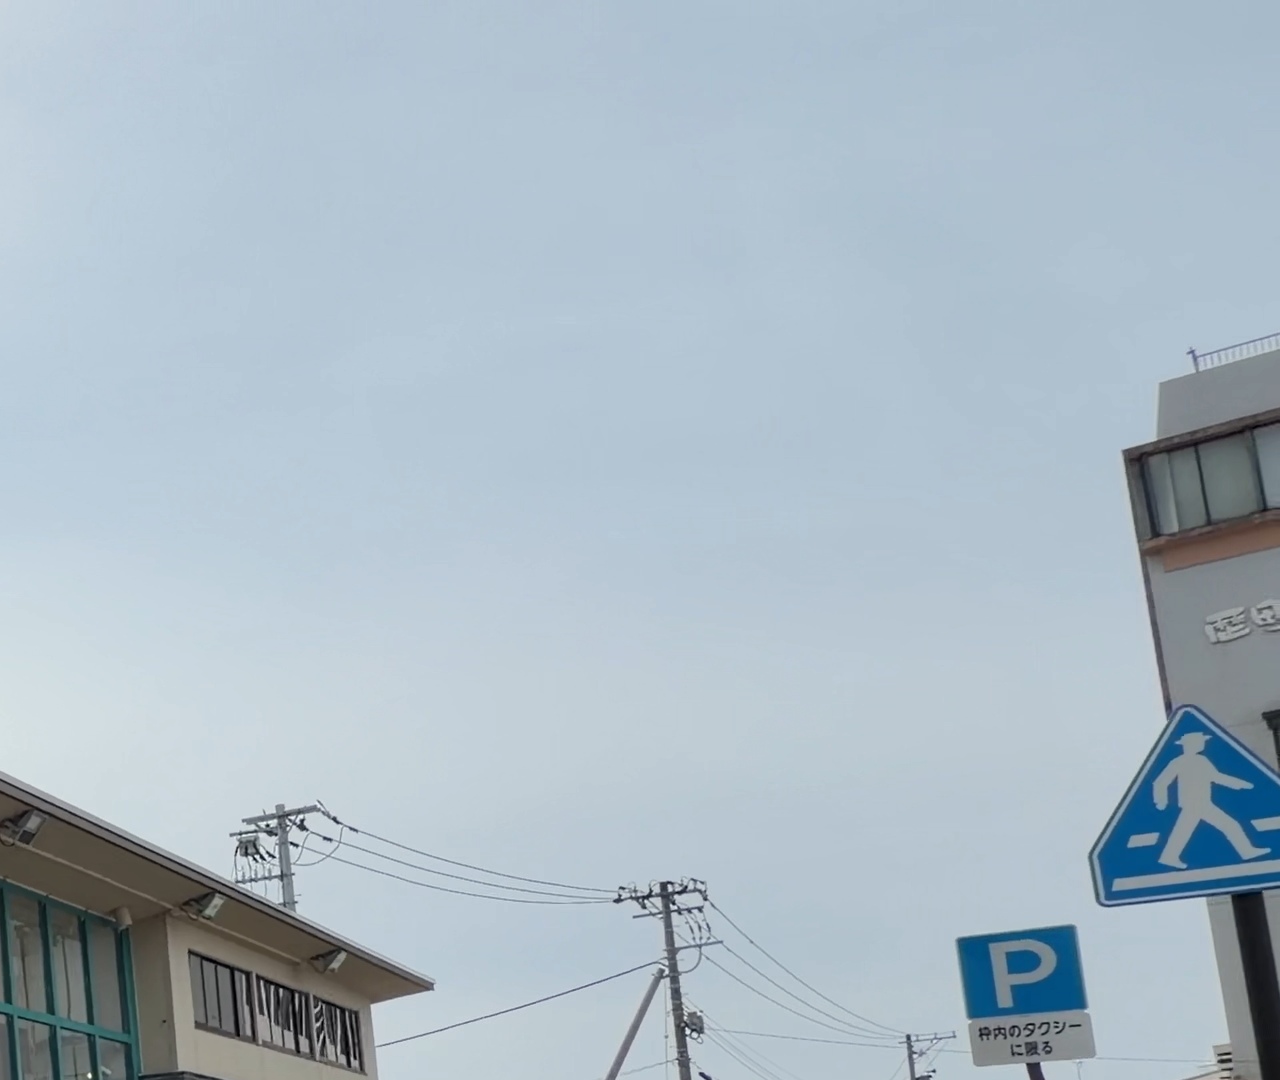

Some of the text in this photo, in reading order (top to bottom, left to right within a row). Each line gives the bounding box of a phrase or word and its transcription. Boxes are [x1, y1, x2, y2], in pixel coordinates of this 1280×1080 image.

[988, 938, 1057, 1009] P
[978, 1020, 1082, 1041] 枠内のタクシー
[1010, 1040, 1053, 1057] に限る
